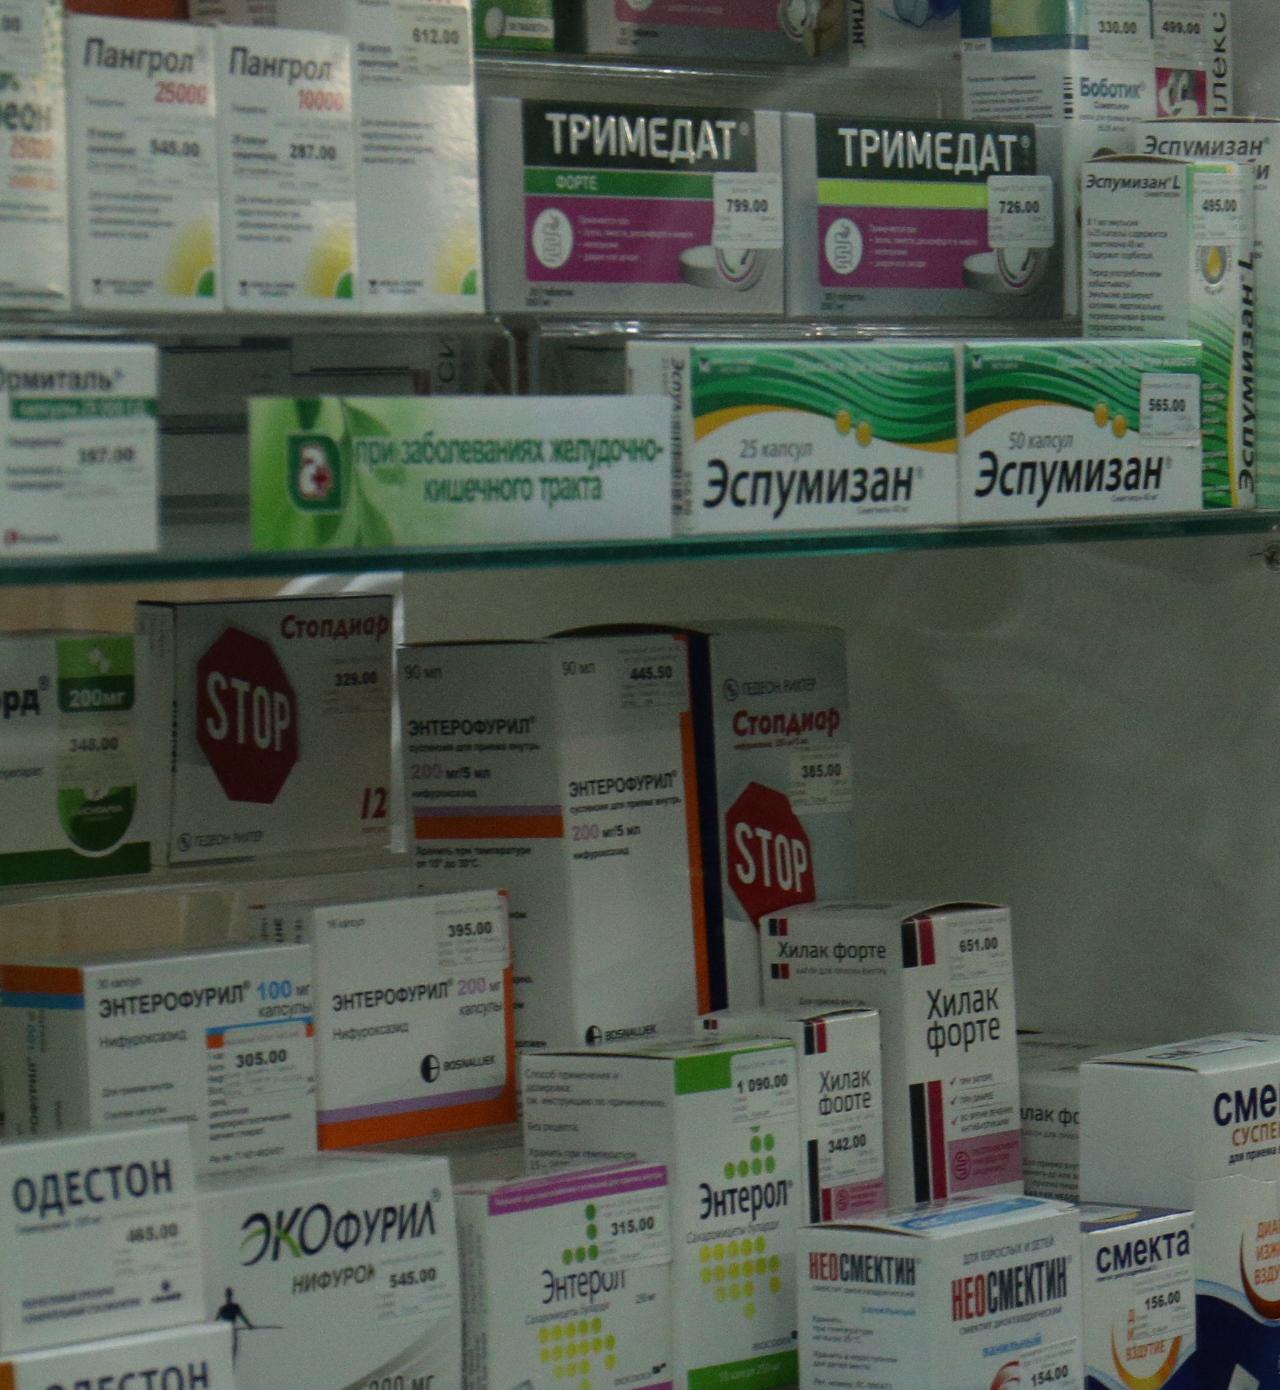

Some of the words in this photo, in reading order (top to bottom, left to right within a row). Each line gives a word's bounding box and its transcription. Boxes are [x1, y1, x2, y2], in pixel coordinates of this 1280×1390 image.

[851, 0, 864, 45] ТИН
[83, 37, 194, 79] Пангрол
[229, 46, 333, 84] Пангрол
[1080, 76, 1142, 100] Боботик
[544, 112, 738, 164] ТРИМЕДАТ
[1143, 135, 1264, 156] Эспумизан
[837, 127, 1018, 176] ТРИМЕДАТ
[554, 174, 598, 191] ФОРТЕ
[1085, 173, 1166, 192] Эспумизан
[1172, 174, 1181, 190] L
[725, 198, 769, 214] 799.00
[998, 201, 1040, 214] 726.00
[0, 368, 111, 391] рмиталь
[1238, 283, 1255, 494] Эспумизан
[1148, 399, 1186, 412] 565.00
[355, 437, 395, 473] при
[400, 430, 544, 465] заболеваниях
[551, 437, 664, 471] желудочно-
[739, 439, 757, 459] 25
[761, 441, 814, 462] капсул
[1009, 431, 1026, 450] 50
[1028, 434, 1074, 453] капсул
[703, 458, 914, 520] Эспумизан
[974, 450, 1164, 508] Эспумизан
[423, 475, 533, 504] кишечного
[538, 475, 603, 510] тракта
[279, 614, 390, 643] Стопдиар
[561, 661, 577, 676] 90
[205, 669, 292, 753] STOP
[732, 707, 840, 738] Стопдиар
[407, 717, 531, 736] ЭНТЕРОФУРИЛ
[410, 764, 443, 780] 200
[568, 772, 674, 799] ЭНТЕРОФУРИЛ
[360, 787, 389, 821] 12
[571, 824, 599, 841] 200
[734, 821, 808, 893] STOP
[447, 921, 493, 938] 395.00
[778, 940, 829, 959] Хилак
[833, 941, 887, 963] форте
[958, 937, 998, 954] 651.00
[98, 983, 245, 1019] ЭНТЕРОФУРИЛ
[256, 979, 292, 1001] 100
[332, 981, 450, 1013] ЭНТЕРОФУРИЛ
[457, 976, 488, 997] 200
[926, 987, 999, 1021] Хилак
[99, 1028, 187, 1050] Нифуроксазид
[332, 1021, 409, 1042] Нифуроксазид
[925, 1015, 1000, 1057] форте
[235, 1048, 287, 1069] 305.00
[818, 1068, 871, 1094] Хилак
[818, 1091, 872, 1117] форте
[827, 1133, 867, 1154] 342.00
[12, 1159, 174, 1219] ОДЕСТОН
[698, 1179, 789, 1222] Энтерол
[239, 1201, 437, 1267] ЭКОФУРИЛ
[610, 1216, 655, 1237] 315.00
[1095, 1228, 1191, 1273] смекта
[389, 1266, 437, 1288] 545.00
[809, 1252, 916, 1286] НЕОСМЕКТИН
[951, 1256, 1068, 1323] НЕОСМЕКТИН
[1144, 1289, 1182, 1311] 156.00
[1030, 1364, 1069, 1388] 154.00
